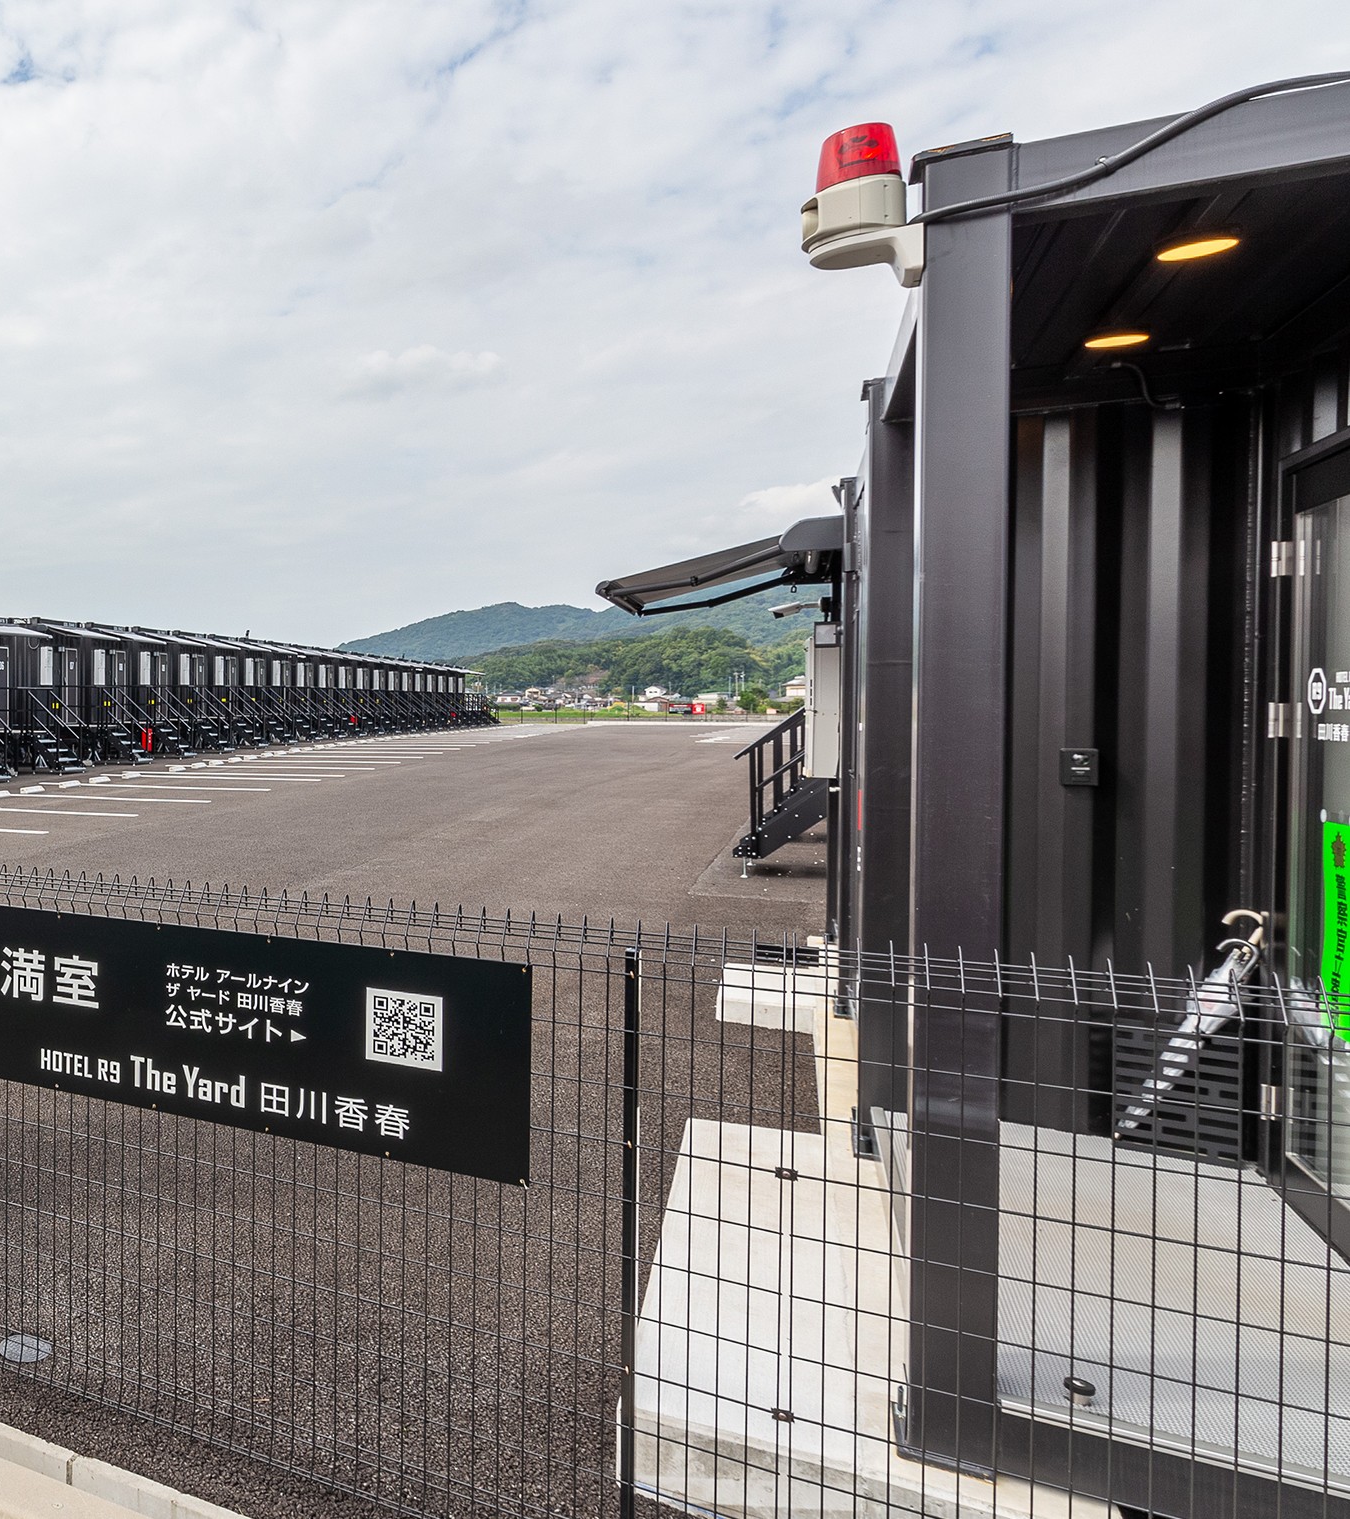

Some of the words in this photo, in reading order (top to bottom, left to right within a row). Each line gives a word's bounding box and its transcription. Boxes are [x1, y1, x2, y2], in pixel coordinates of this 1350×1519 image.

[0, 945, 101, 1010] 満室
[165, 962, 210, 983] ホテル
[216, 968, 310, 995] アールナイン
[165, 982, 181, 998] ザ
[186, 985, 231, 1006] ヤード
[237, 992, 303, 1017] 田川香春
[165, 1003, 283, 1043] 公式サイト
[40, 1047, 93, 1079] HOTEL
[97, 1058, 121, 1084] R9
[129, 1054, 177, 1095] The
[182, 1064, 247, 1109] Yard
[260, 1082, 410, 1140] 田川香春
